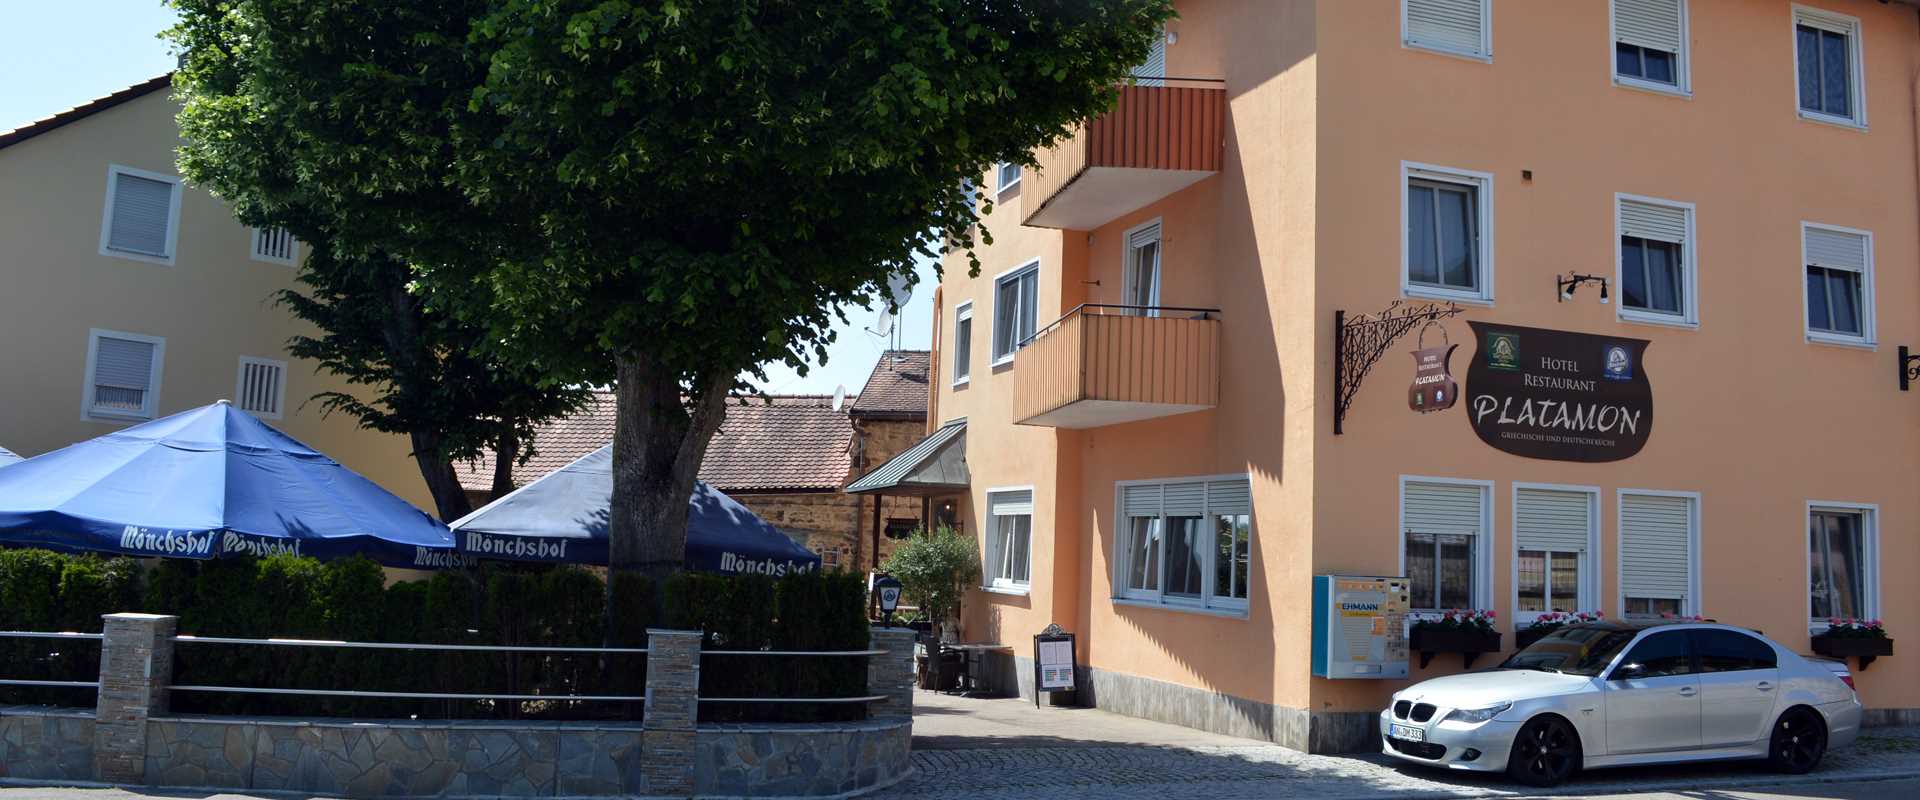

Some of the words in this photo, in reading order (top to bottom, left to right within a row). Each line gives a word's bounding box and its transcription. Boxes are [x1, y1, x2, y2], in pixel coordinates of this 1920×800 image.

[1541, 356, 1579, 373] HOTEL
[1524, 373, 1596, 392] RESTAURANT
[1473, 395, 1640, 435] PLATAMON
[1501, 431, 1544, 441] GRIECHISCHE
[120, 525, 215, 556] Mönchshof
[466, 532, 568, 558] Mönchshof
